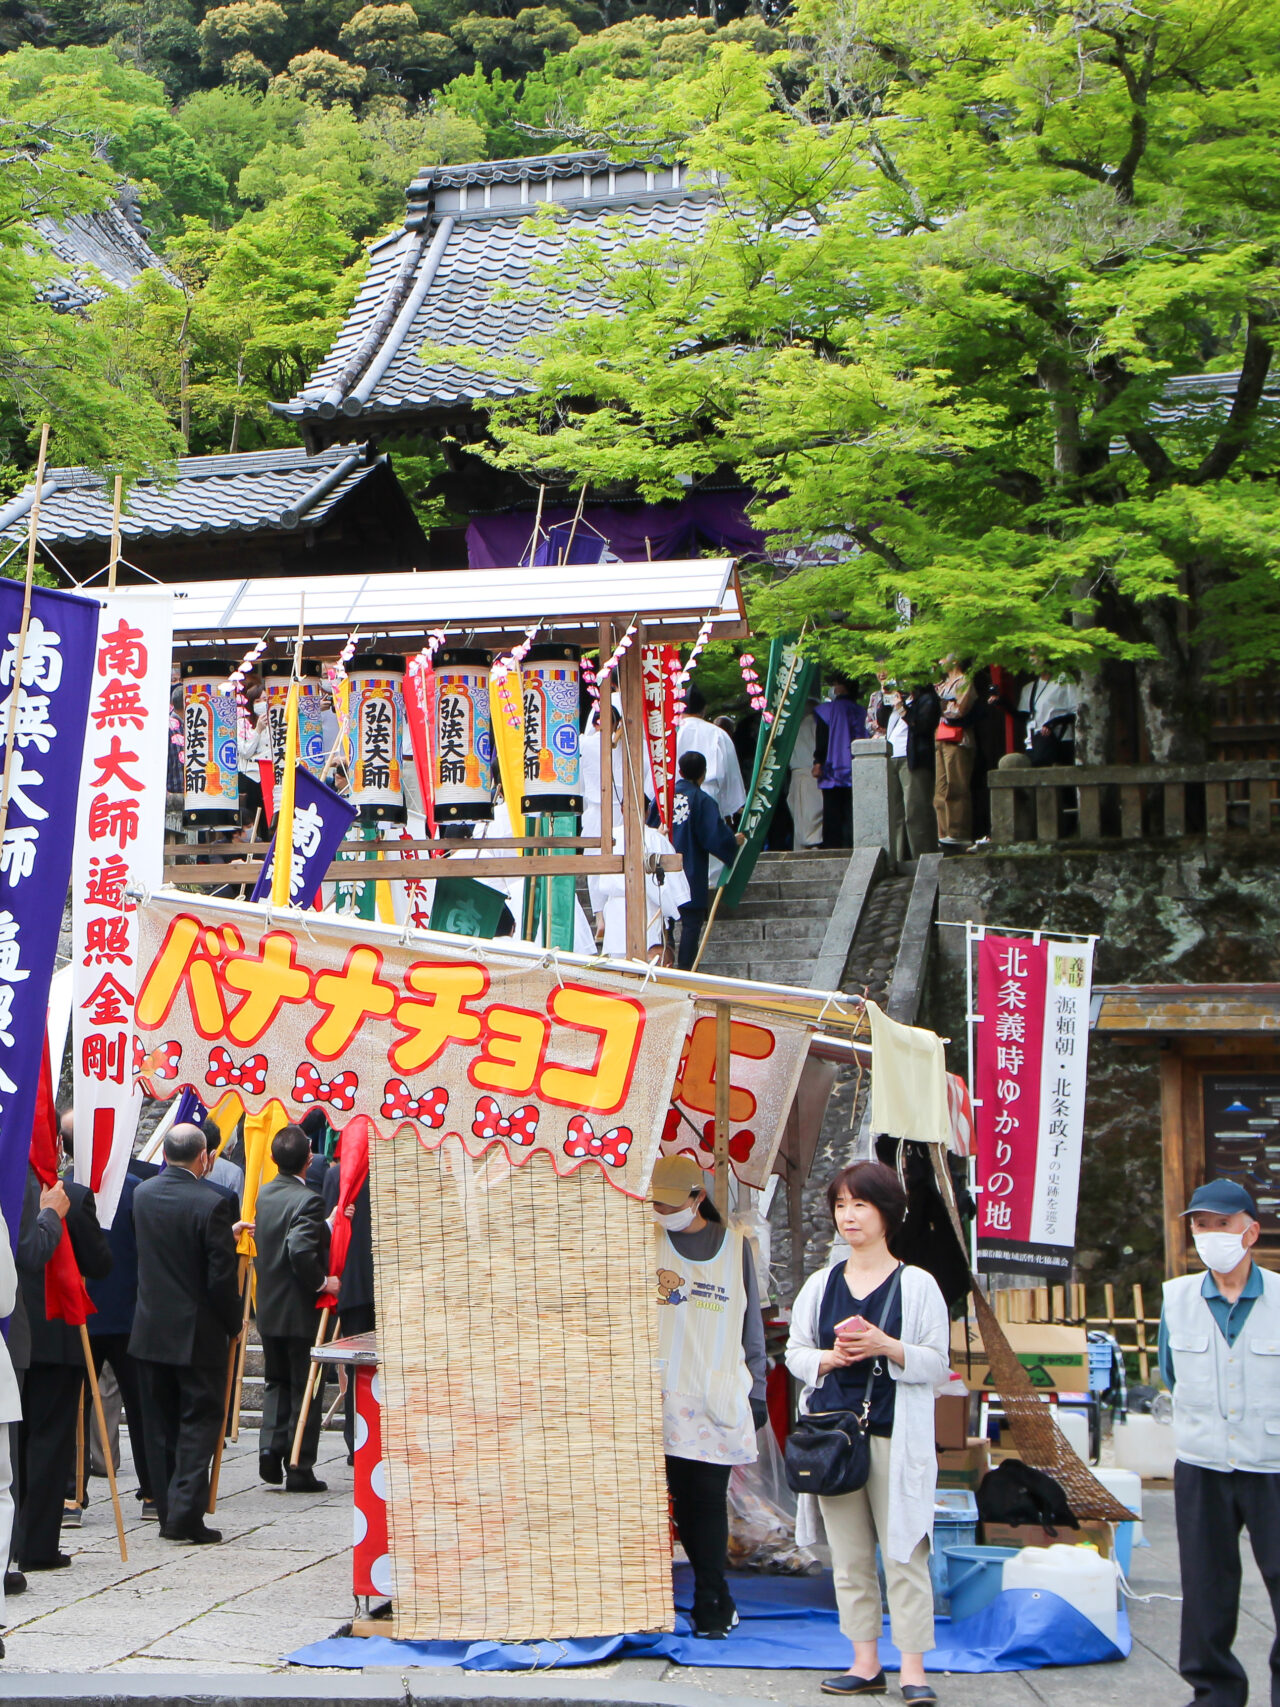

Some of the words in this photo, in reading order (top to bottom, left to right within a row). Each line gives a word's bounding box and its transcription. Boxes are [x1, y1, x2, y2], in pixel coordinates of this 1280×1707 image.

[186, 707, 208, 794] 弘法大師
[362, 702, 391, 790] 弘法大師
[440, 698, 466, 785] 弘法大師
[79, 619, 149, 1085] 南無大師遍照金剛
[134, 912, 646, 1115] バナナチョコ
[983, 946, 1029, 1231] 北条義時ゆかりの地
